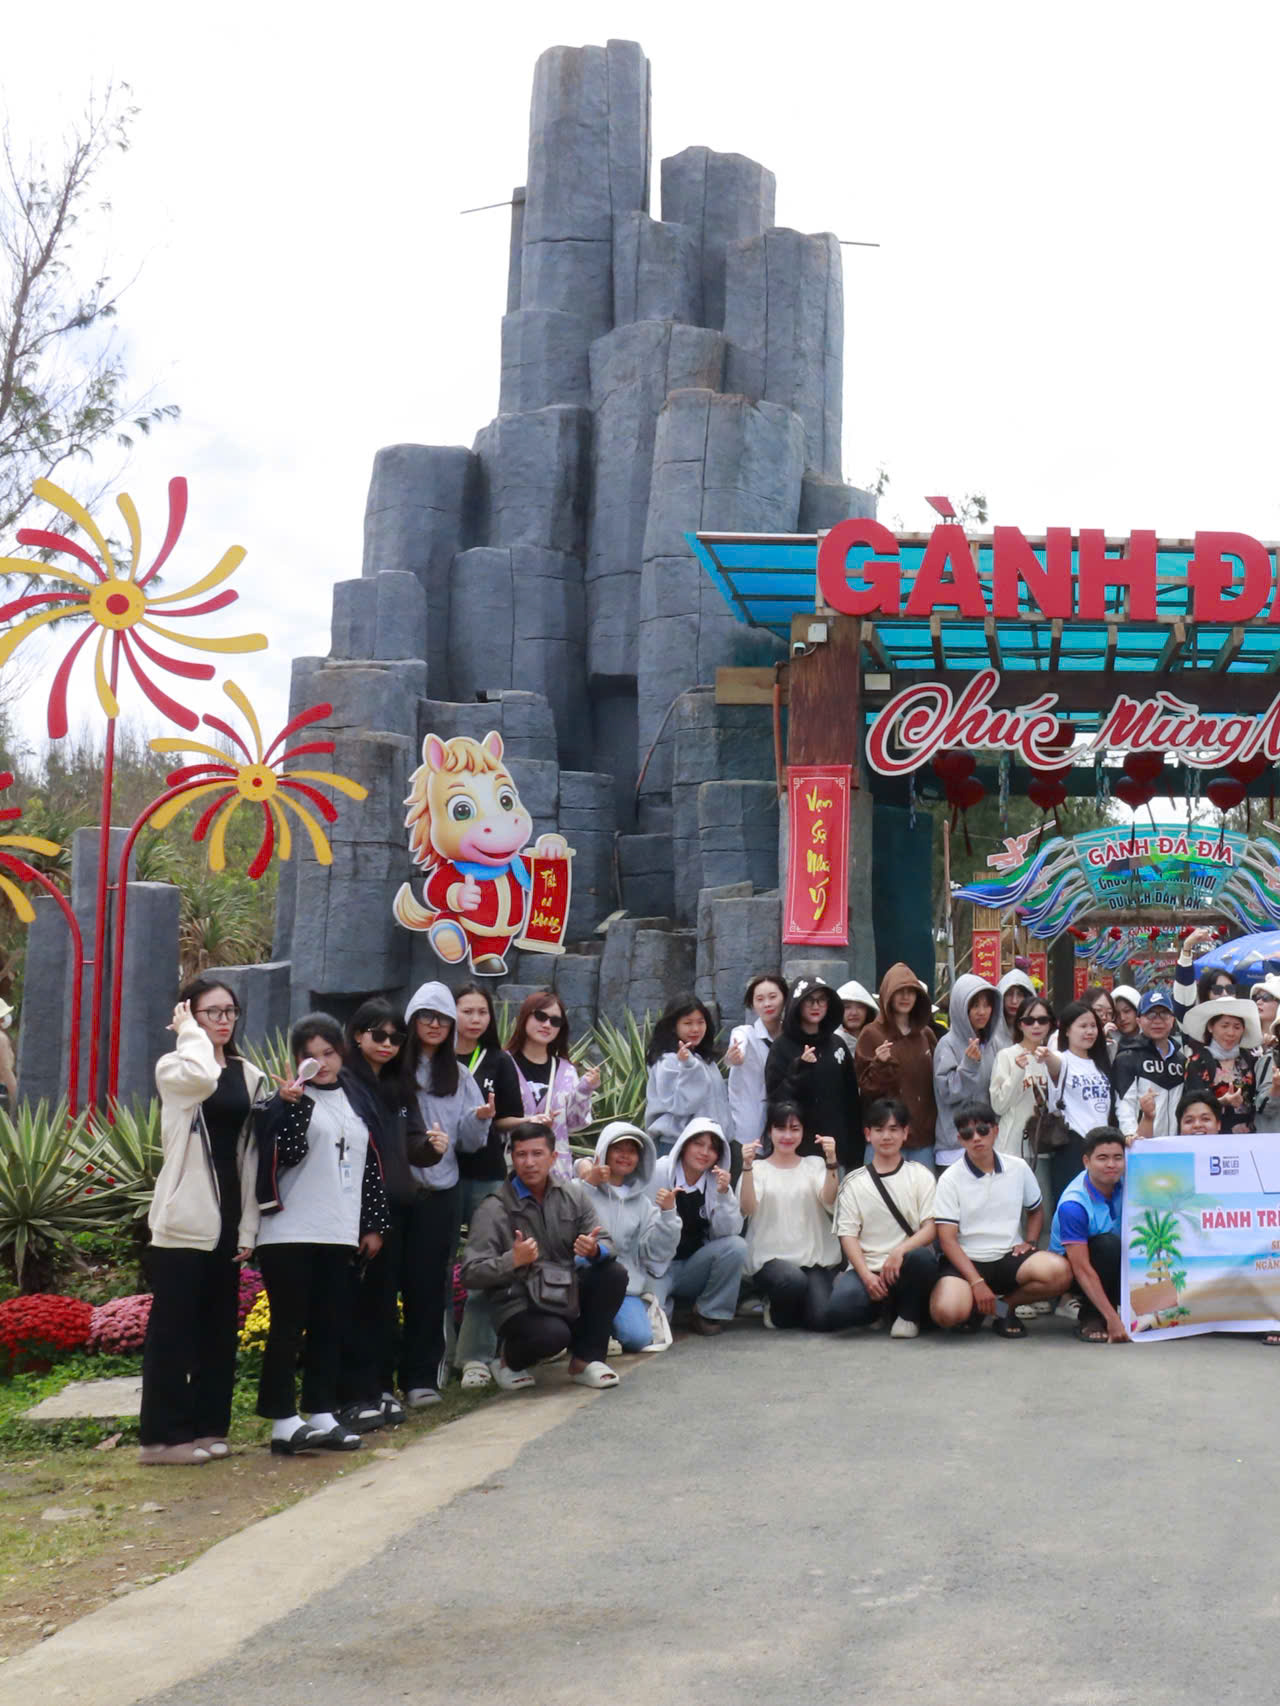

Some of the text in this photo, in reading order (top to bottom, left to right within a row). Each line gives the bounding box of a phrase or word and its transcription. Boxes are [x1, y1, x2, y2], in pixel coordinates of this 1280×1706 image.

[818, 496, 1157, 620] GÀNH
[865, 667, 1096, 776] Chúc
[1091, 690, 1258, 769] Mừng
[806, 785, 832, 812] Vạn
[1088, 838, 1149, 866] GÀNH
[1156, 832, 1190, 855] ĐÁ
[1202, 1207, 1251, 1229] HÀNH
